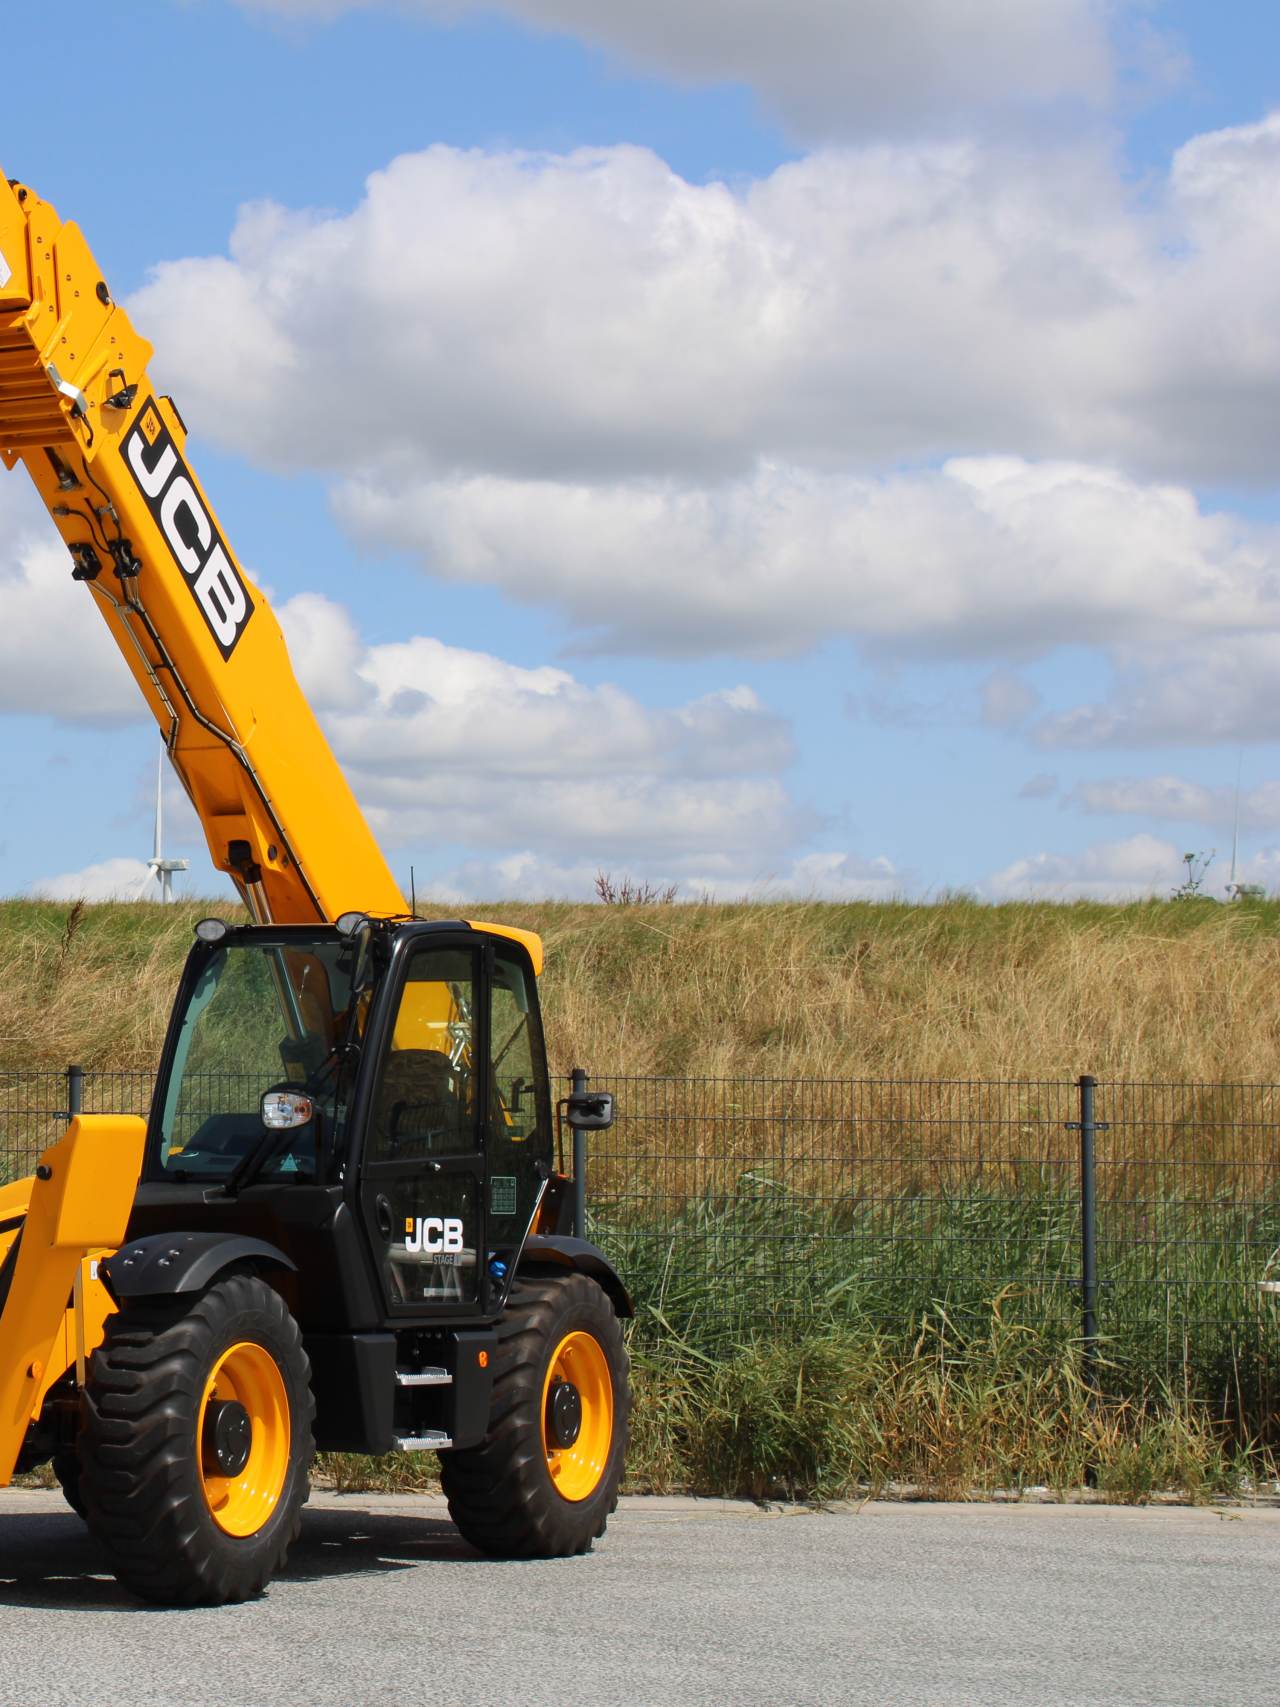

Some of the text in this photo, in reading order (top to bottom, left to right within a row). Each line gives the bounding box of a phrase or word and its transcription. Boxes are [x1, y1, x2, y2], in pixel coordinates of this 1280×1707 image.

[127, 431, 246, 647] JCB
[405, 1217, 463, 1253] JCB
[433, 1254, 453, 1265] STAGE
